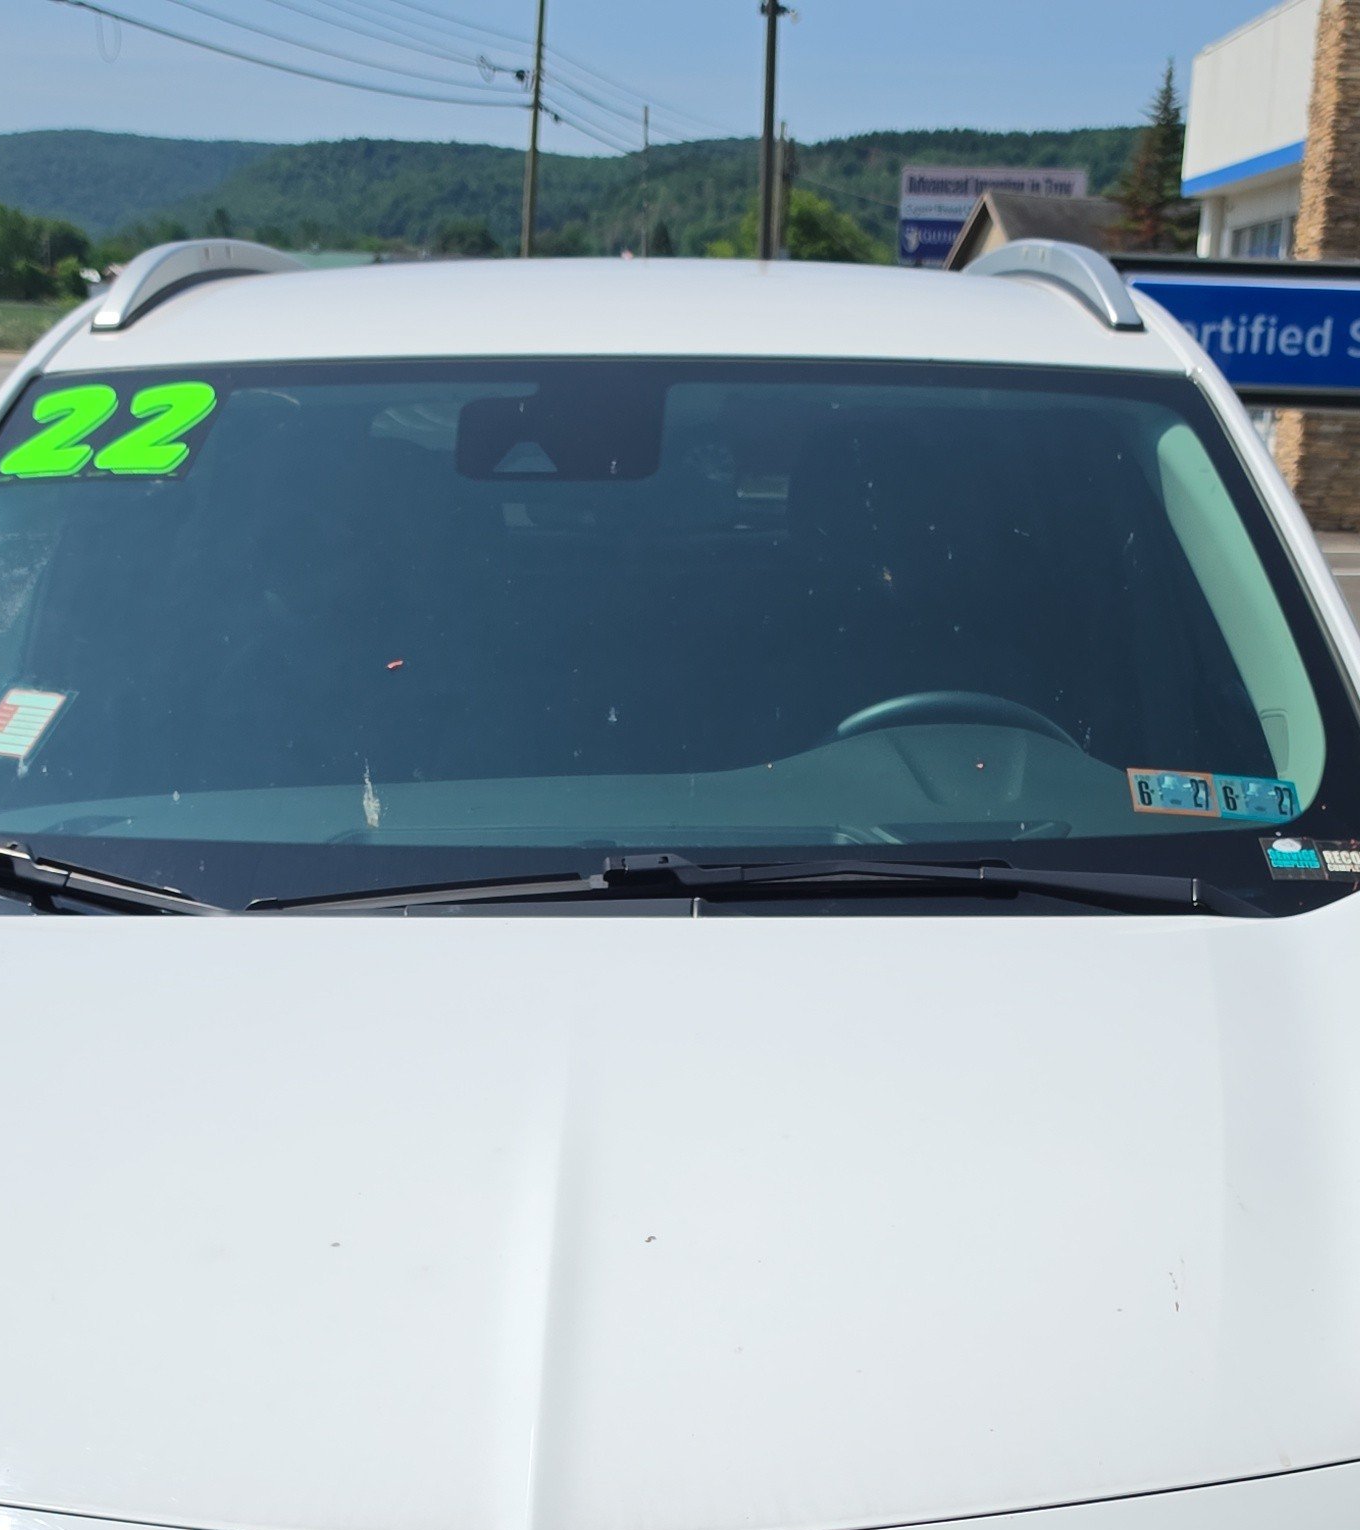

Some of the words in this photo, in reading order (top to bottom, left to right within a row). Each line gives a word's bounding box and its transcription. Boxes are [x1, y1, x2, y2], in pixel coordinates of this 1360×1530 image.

[1181, 312, 1334, 358] rtified
[1138, 780, 1153, 806] 6
[1190, 778, 1210, 811] 27
[1222, 785, 1238, 811] 6
[1274, 786, 1294, 817] 27
